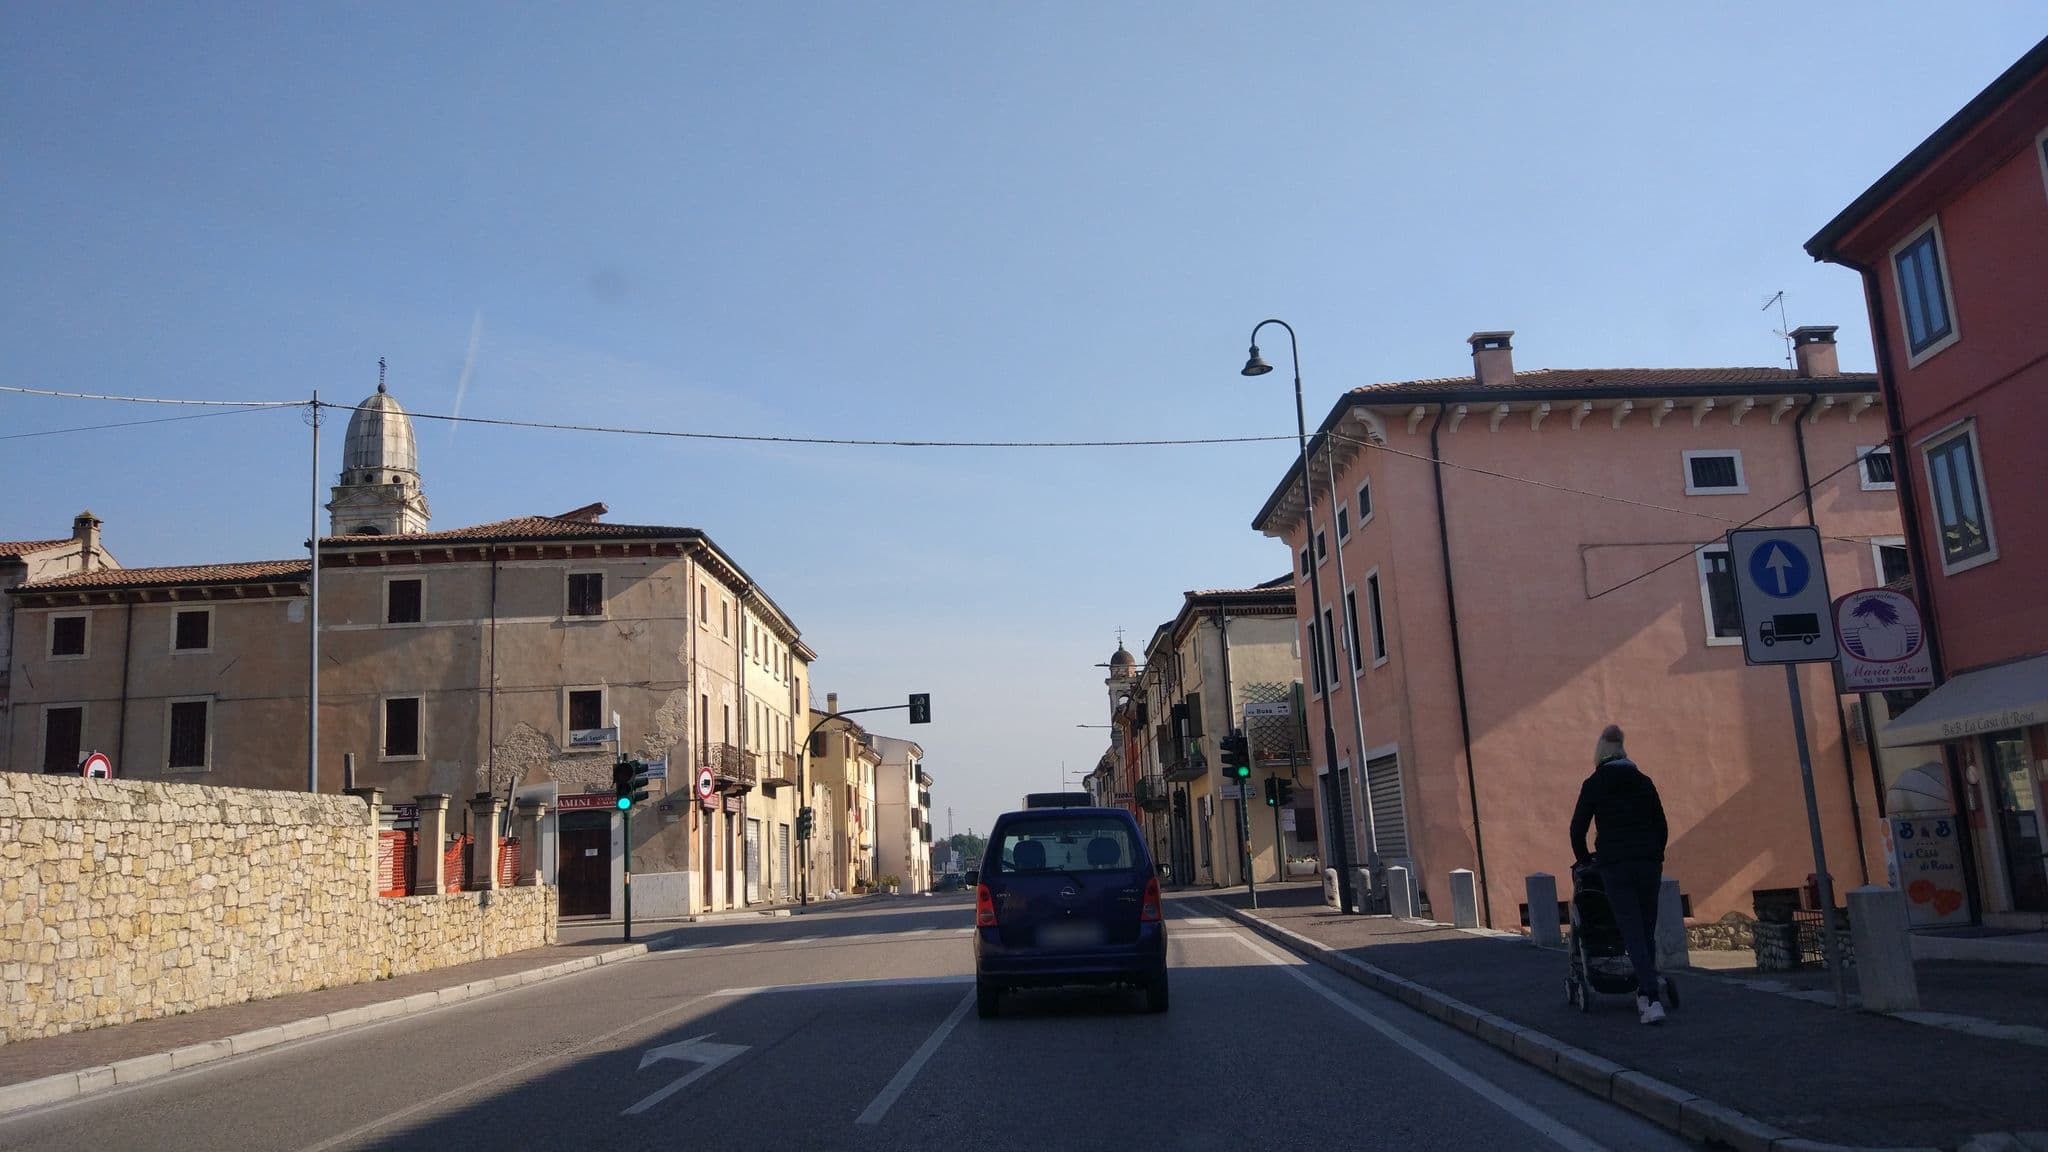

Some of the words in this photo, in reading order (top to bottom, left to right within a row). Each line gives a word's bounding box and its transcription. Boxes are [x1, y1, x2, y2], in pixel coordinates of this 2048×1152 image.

[1848, 664, 1890, 678] Maria
[1894, 662, 1929, 674] Rosa
[2010, 711, 2034, 725] Rosa
[1931, 860, 1954, 871] Rosa
